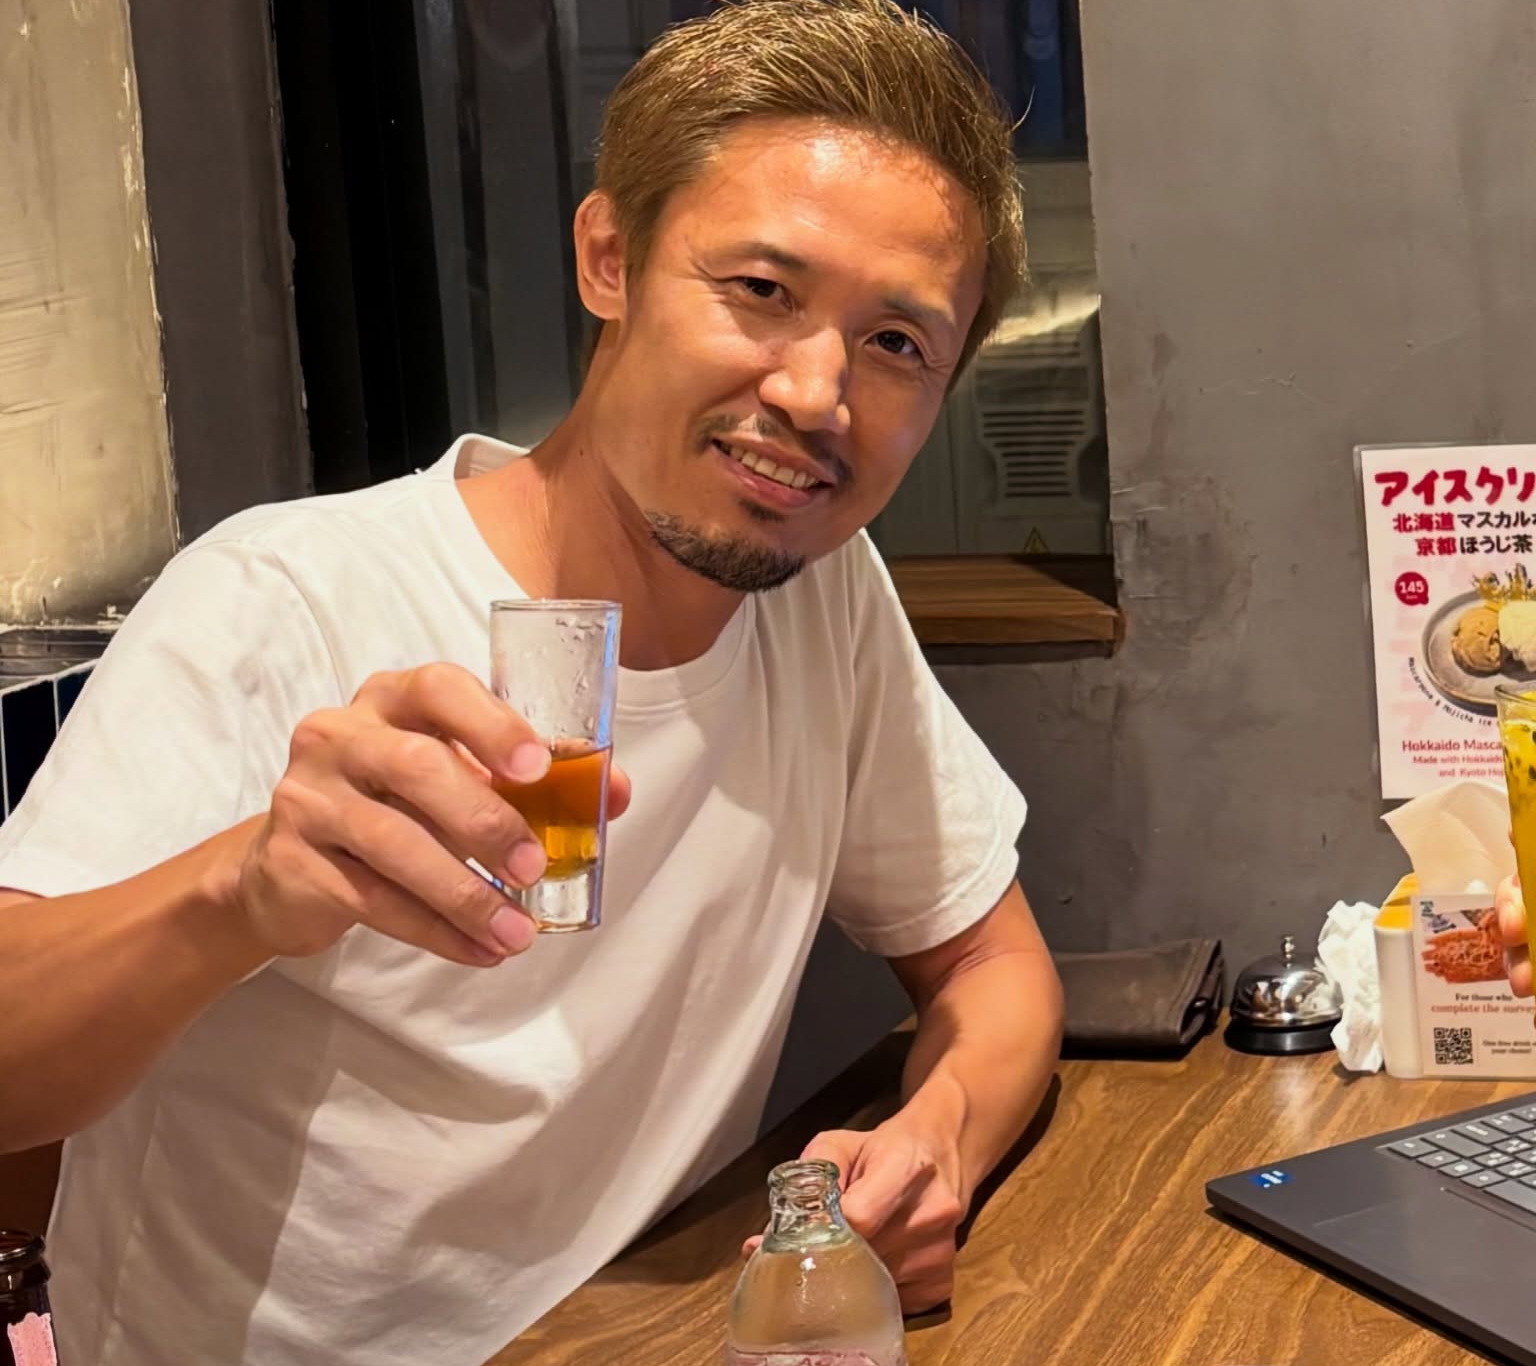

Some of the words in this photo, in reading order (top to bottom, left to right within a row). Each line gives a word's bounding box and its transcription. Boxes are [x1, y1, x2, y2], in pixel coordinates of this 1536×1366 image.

[1400, 580, 1424, 593] 145
[1402, 739, 1460, 752] Hokkaido
[1463, 739, 1503, 751] Masca
[1462, 755, 1503, 764] Hokkaid
